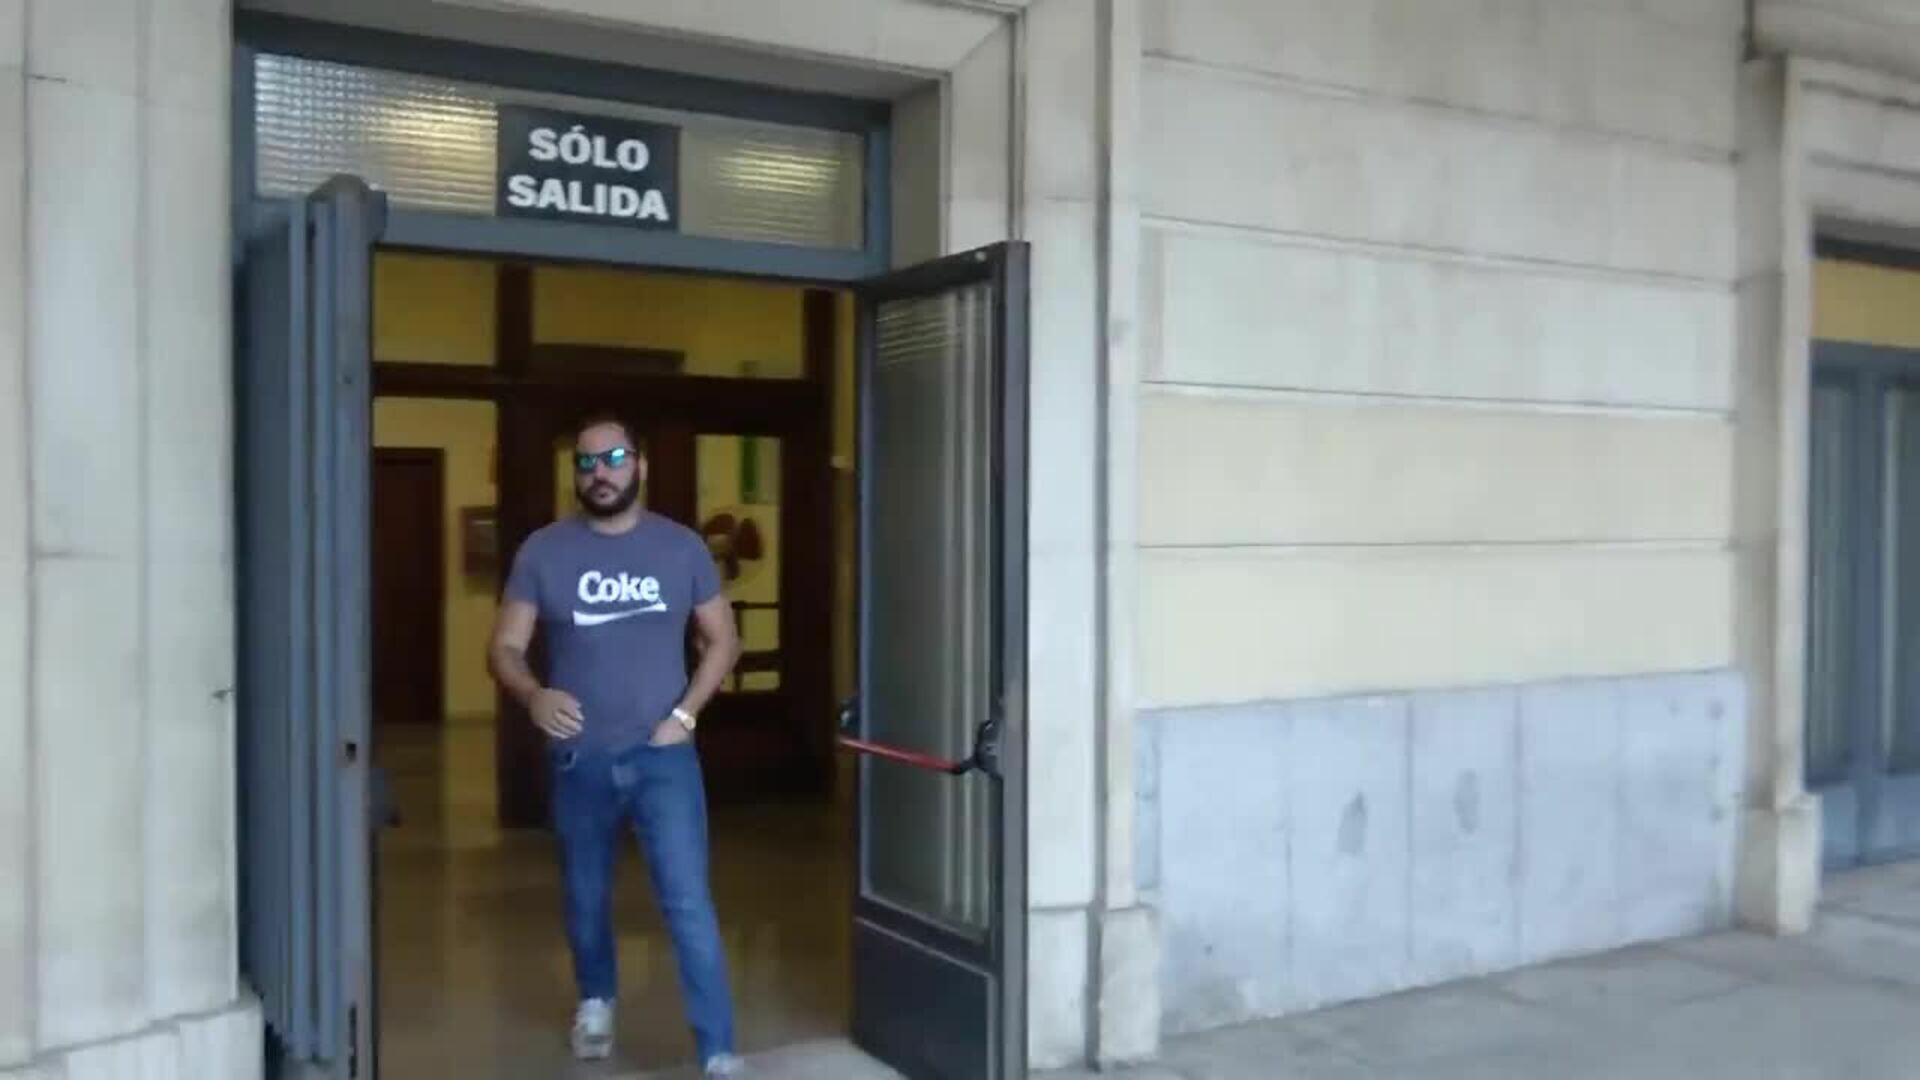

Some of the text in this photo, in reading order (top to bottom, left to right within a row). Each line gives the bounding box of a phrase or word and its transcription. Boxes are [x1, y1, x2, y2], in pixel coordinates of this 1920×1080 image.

[528, 124, 650, 172] SÓLO
[507, 174, 669, 221] SALIDA
[578, 570, 660, 604] Coke
